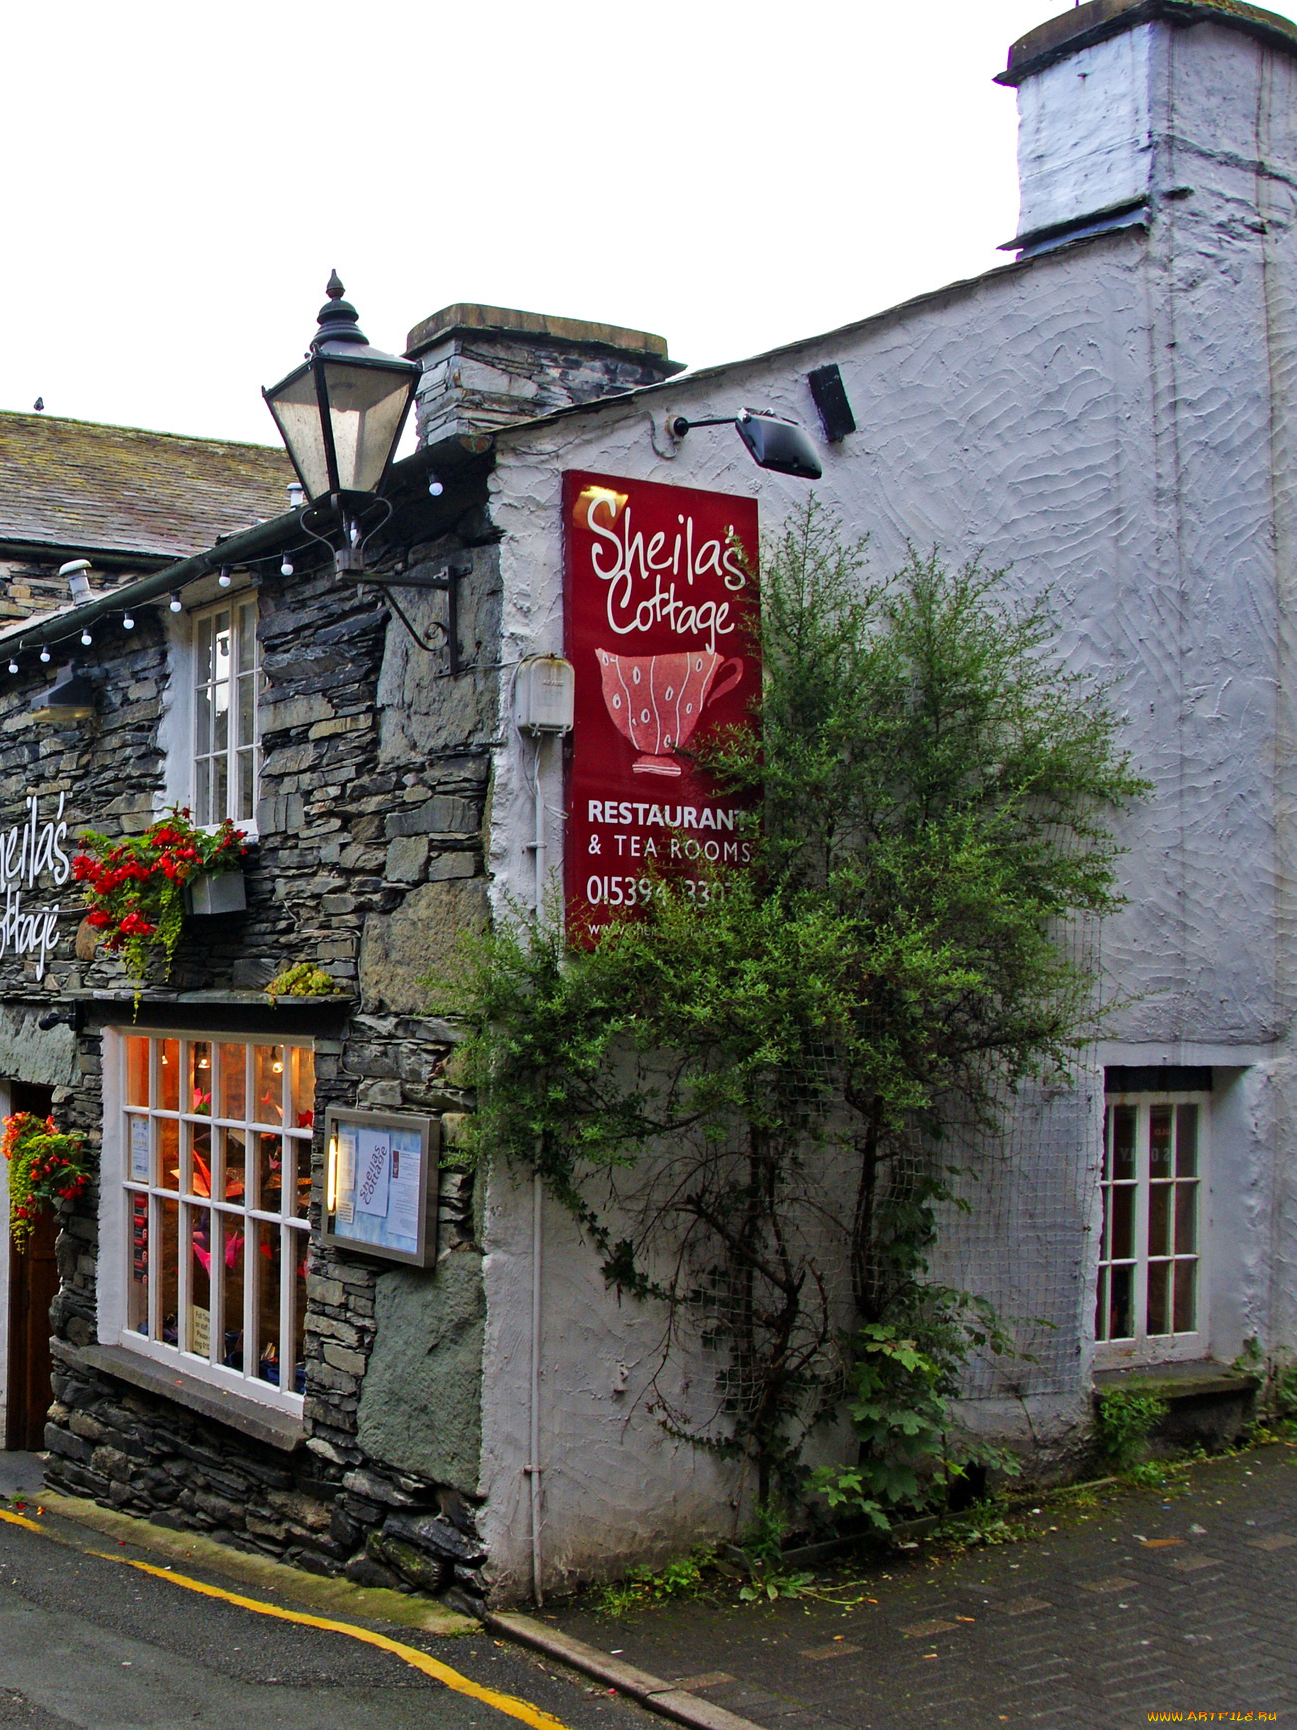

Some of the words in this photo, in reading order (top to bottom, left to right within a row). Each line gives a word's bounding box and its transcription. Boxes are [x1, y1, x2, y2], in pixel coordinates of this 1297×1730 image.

[587, 496, 746, 591] Sheila's
[607, 569, 735, 655] Cottage
[588, 834, 602, 855] &
[614, 835, 658, 858] TEA
[670, 838, 751, 863] ROOMS
